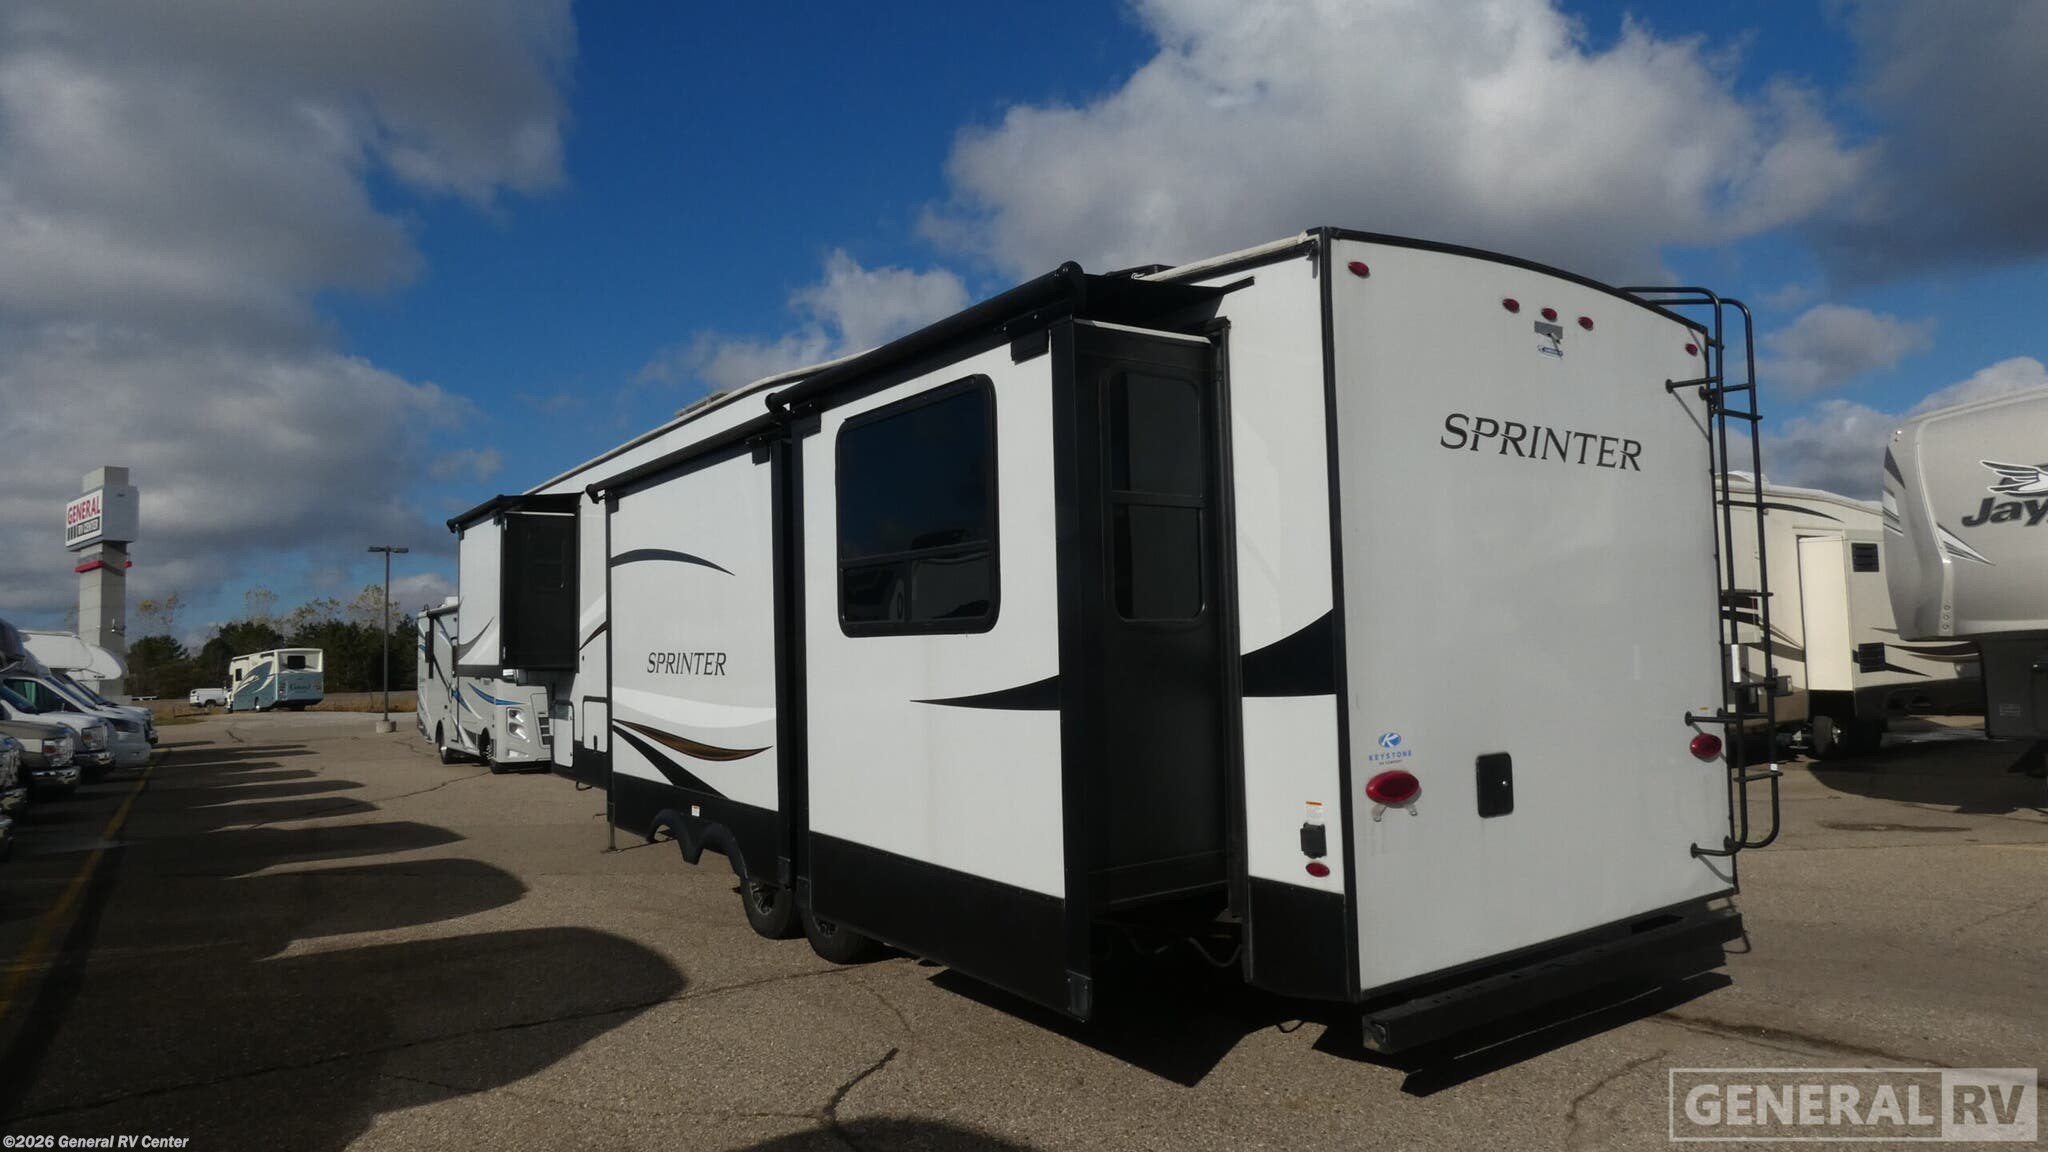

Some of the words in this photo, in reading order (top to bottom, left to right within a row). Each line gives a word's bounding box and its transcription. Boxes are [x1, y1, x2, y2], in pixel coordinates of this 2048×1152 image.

[1440, 413, 1642, 472] SPRINTER
[67, 495, 101, 525] GENERAL
[1961, 496, 2048, 527] Jay
[647, 652, 727, 676] SPRINTER
[1368, 750, 1411, 761] KEYSTONE
